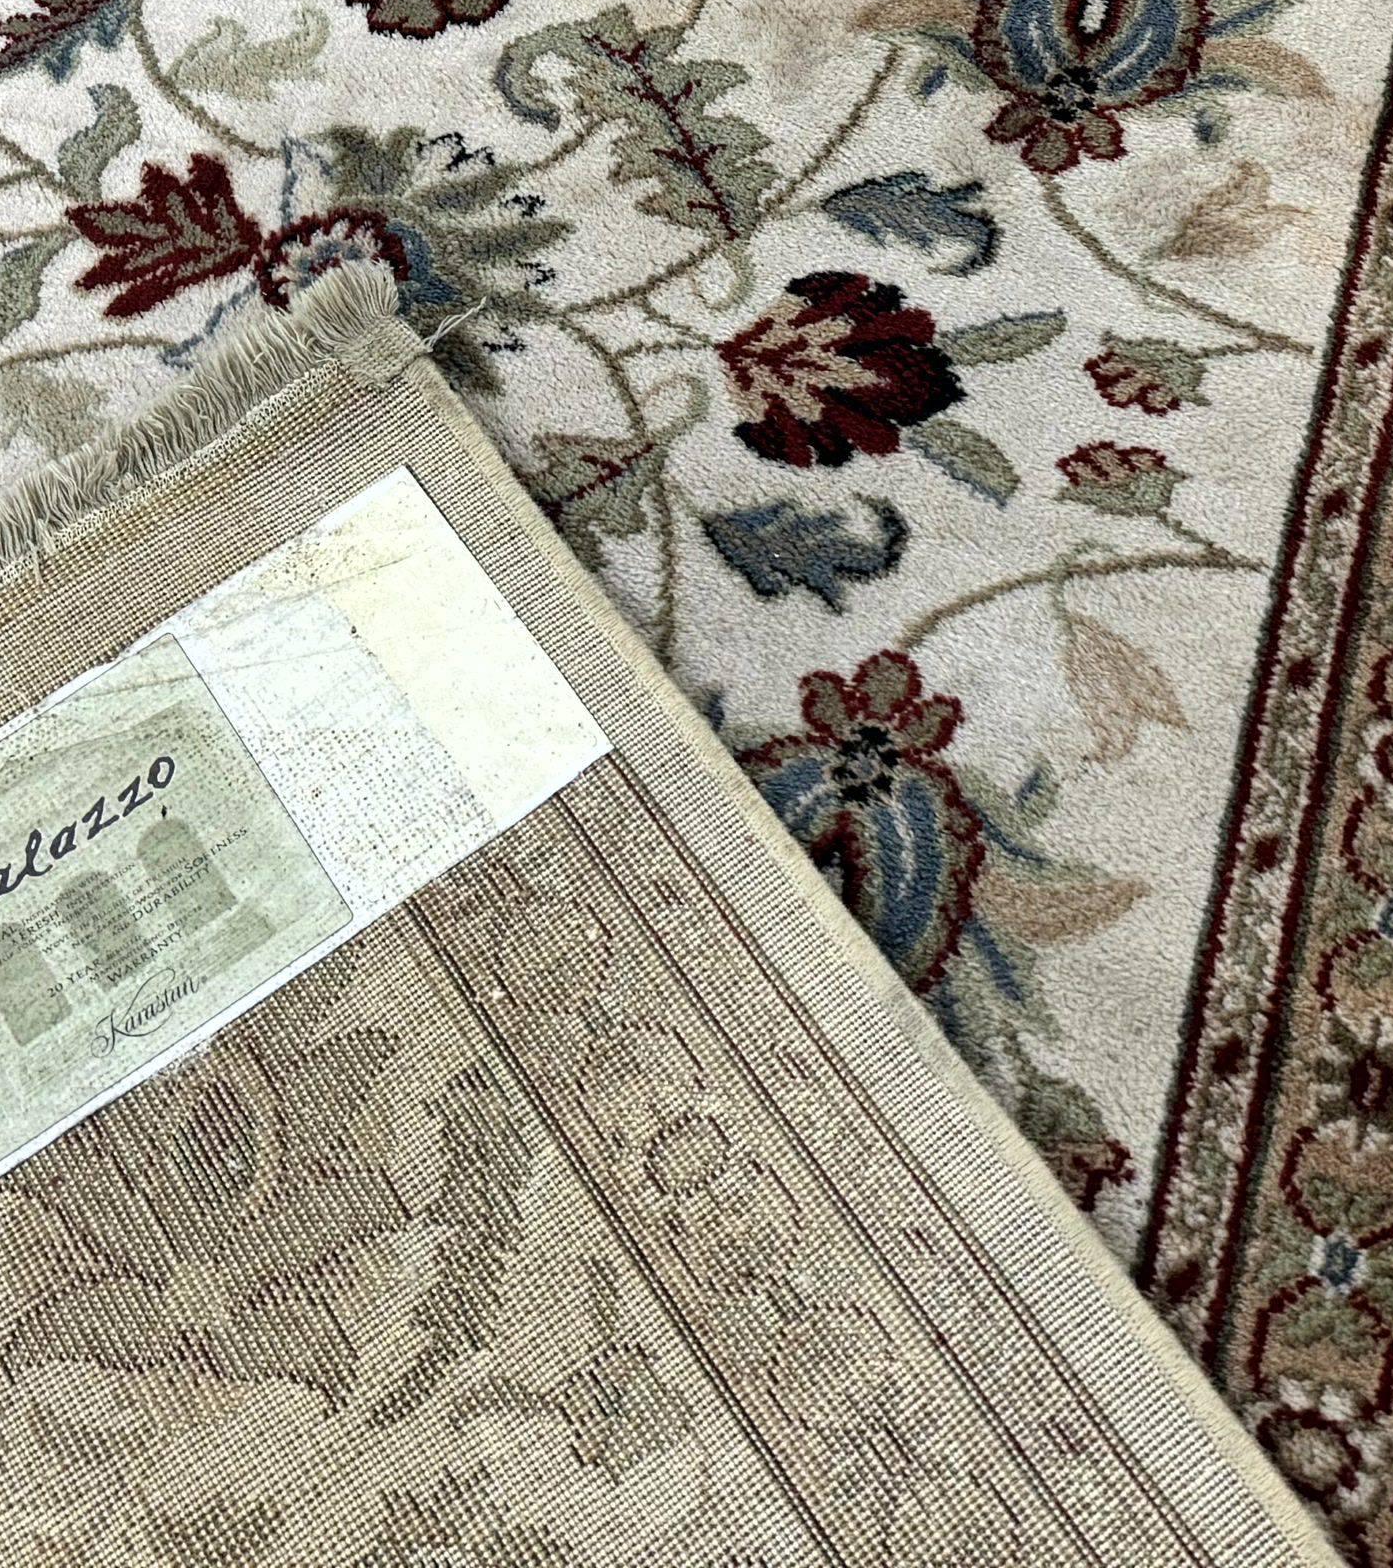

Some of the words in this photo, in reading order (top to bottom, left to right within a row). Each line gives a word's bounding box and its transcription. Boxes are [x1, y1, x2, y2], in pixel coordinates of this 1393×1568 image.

[183, 824, 250, 873] SOFTNESS
[131, 863, 211, 921] DURABILITY
[17, 908, 60, 941] FRESH
[46, 981, 64, 997] 20
[65, 956, 102, 985] YEAR
[107, 928, 183, 983] WARRANTY
[90, 968, 204, 1060] Karastan
